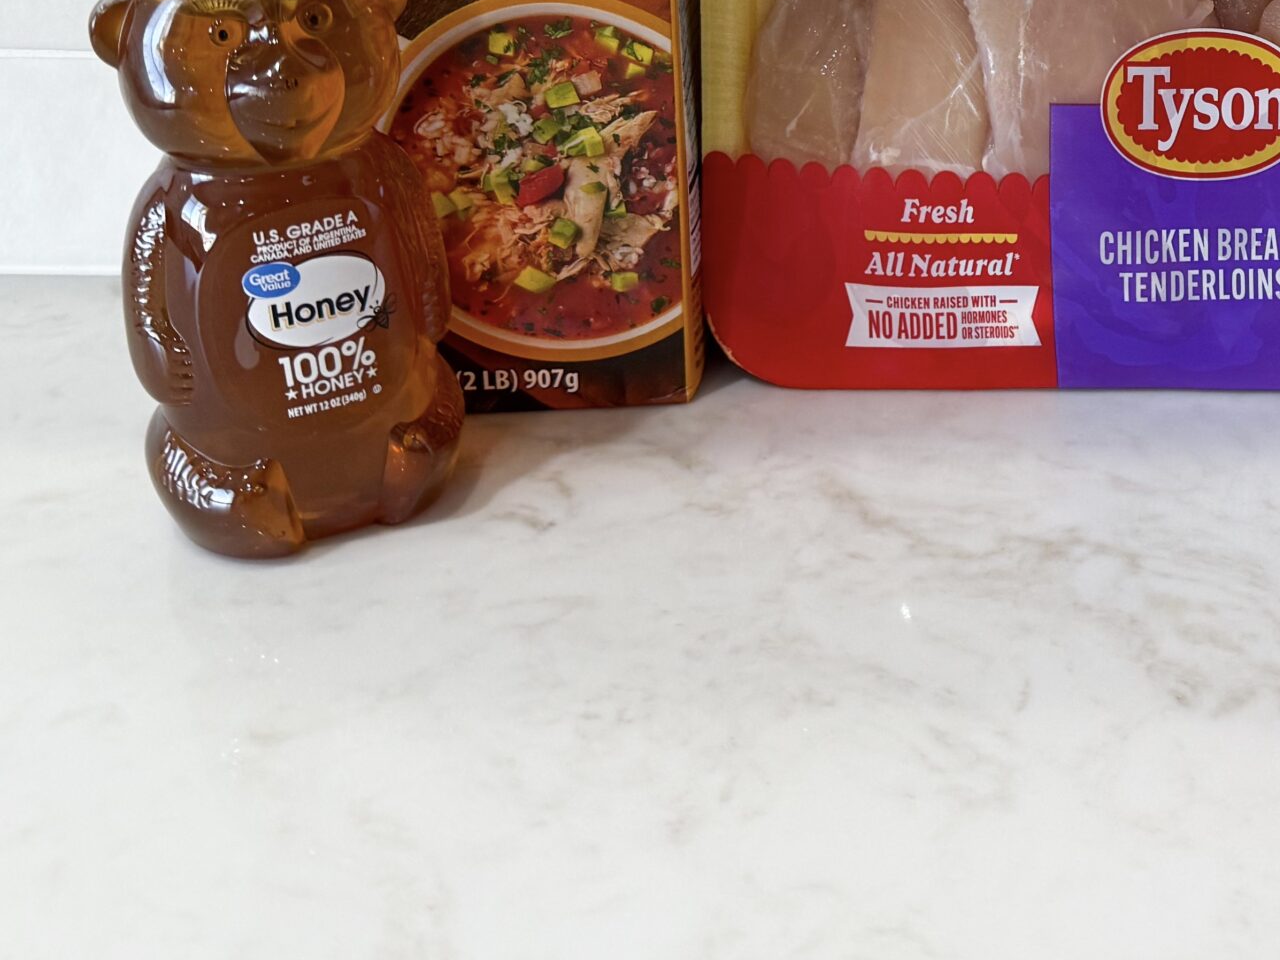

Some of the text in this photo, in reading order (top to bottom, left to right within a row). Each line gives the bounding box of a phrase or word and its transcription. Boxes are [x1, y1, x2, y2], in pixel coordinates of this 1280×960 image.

[900, 198, 975, 224] Fresh
[253, 210, 358, 245] U.S. GRADE A
[250, 228, 366, 263] CANADA, AND UNITED STATES
[257, 240, 297, 255] PRODUCT
[298, 237, 310, 247] OF
[1100, 228, 1209, 265] CHICKEN
[864, 251, 905, 277] All
[249, 269, 290, 286] Great
[260, 281, 291, 292] Value
[269, 285, 370, 330] Honey
[886, 295, 996, 309] CHICKEN RAISED WITH
[868, 310, 958, 340] NO ADDED
[961, 310, 1008, 324] HORMONES
[962, 326, 974, 339] OR
[278, 336, 376, 388] 100%
[301, 368, 365, 399] HONEY
[482, 369, 518, 393] LB)
[523, 369, 579, 393] 907g
[287, 389, 367, 419] NET WT 12 OZ (340g)
